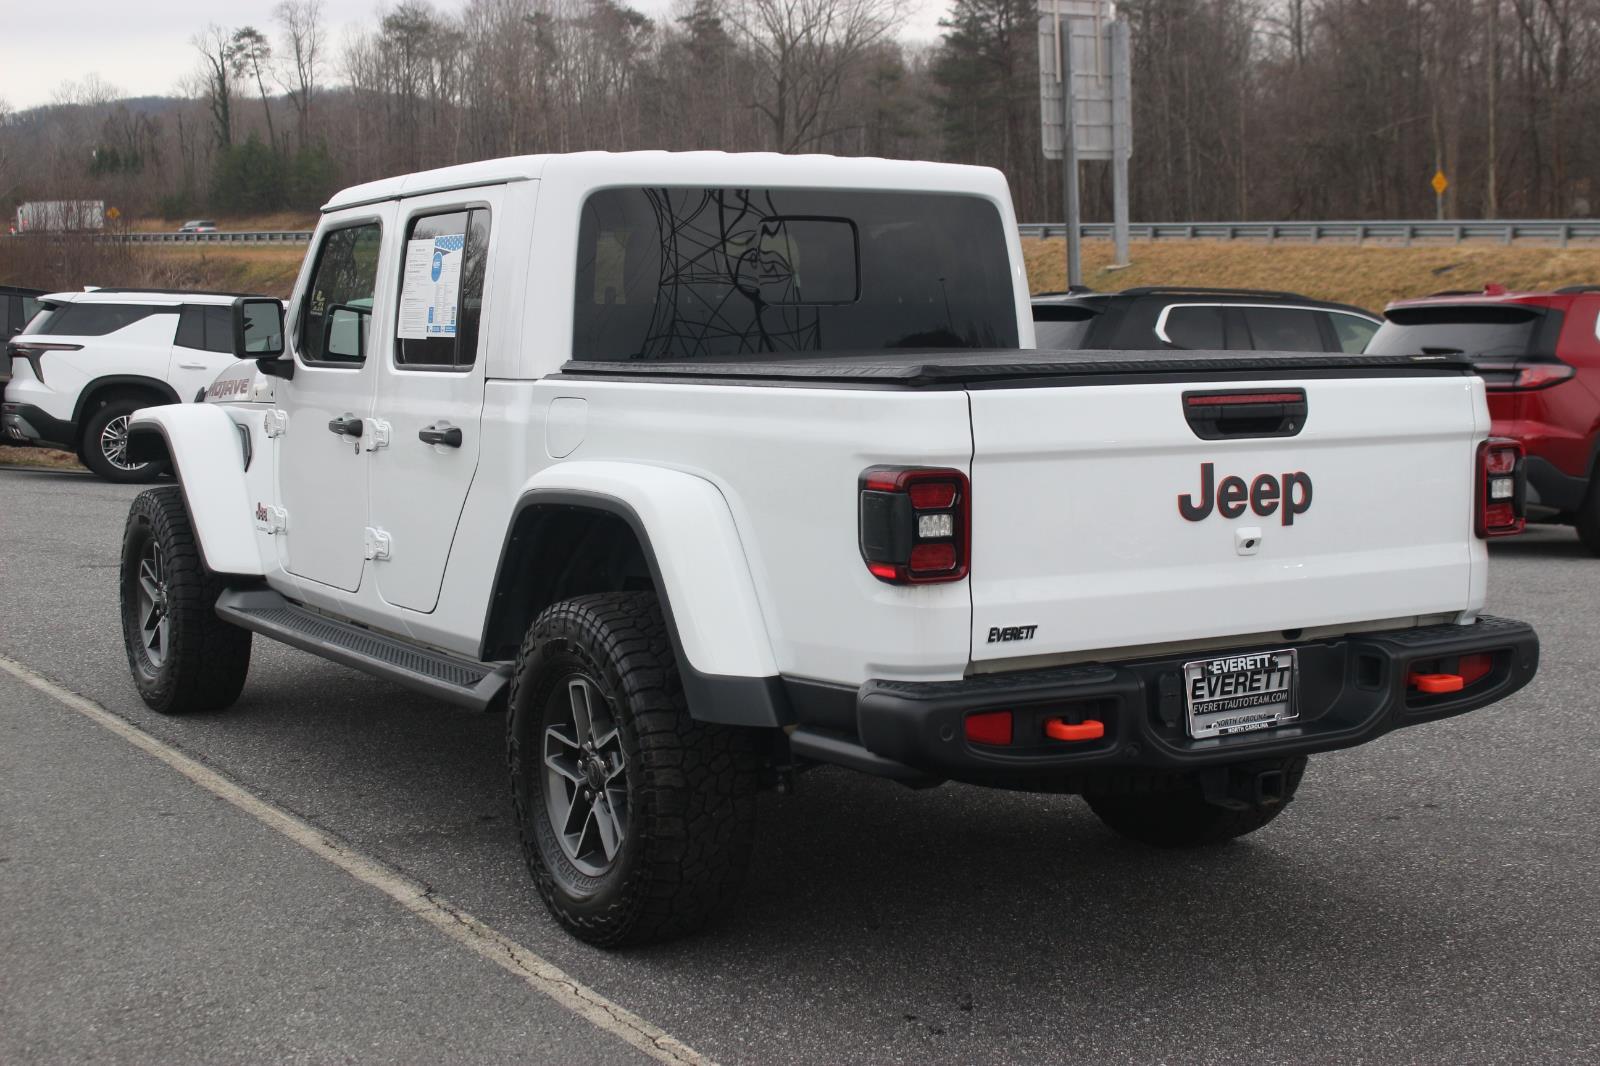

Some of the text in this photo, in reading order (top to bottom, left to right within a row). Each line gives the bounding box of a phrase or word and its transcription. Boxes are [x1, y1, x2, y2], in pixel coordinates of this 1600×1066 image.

[1177, 462, 1313, 526] Jeep
[987, 625, 1038, 643] EVERETT
[1213, 654, 1271, 674] EVERETT
[1191, 666, 1291, 700] EVERETT
[1193, 691, 1288, 714] EVERETTAUTOTEAM.COM
[1217, 718, 1238, 727] NORTH
[1245, 722, 1269, 731] CAROLINA
